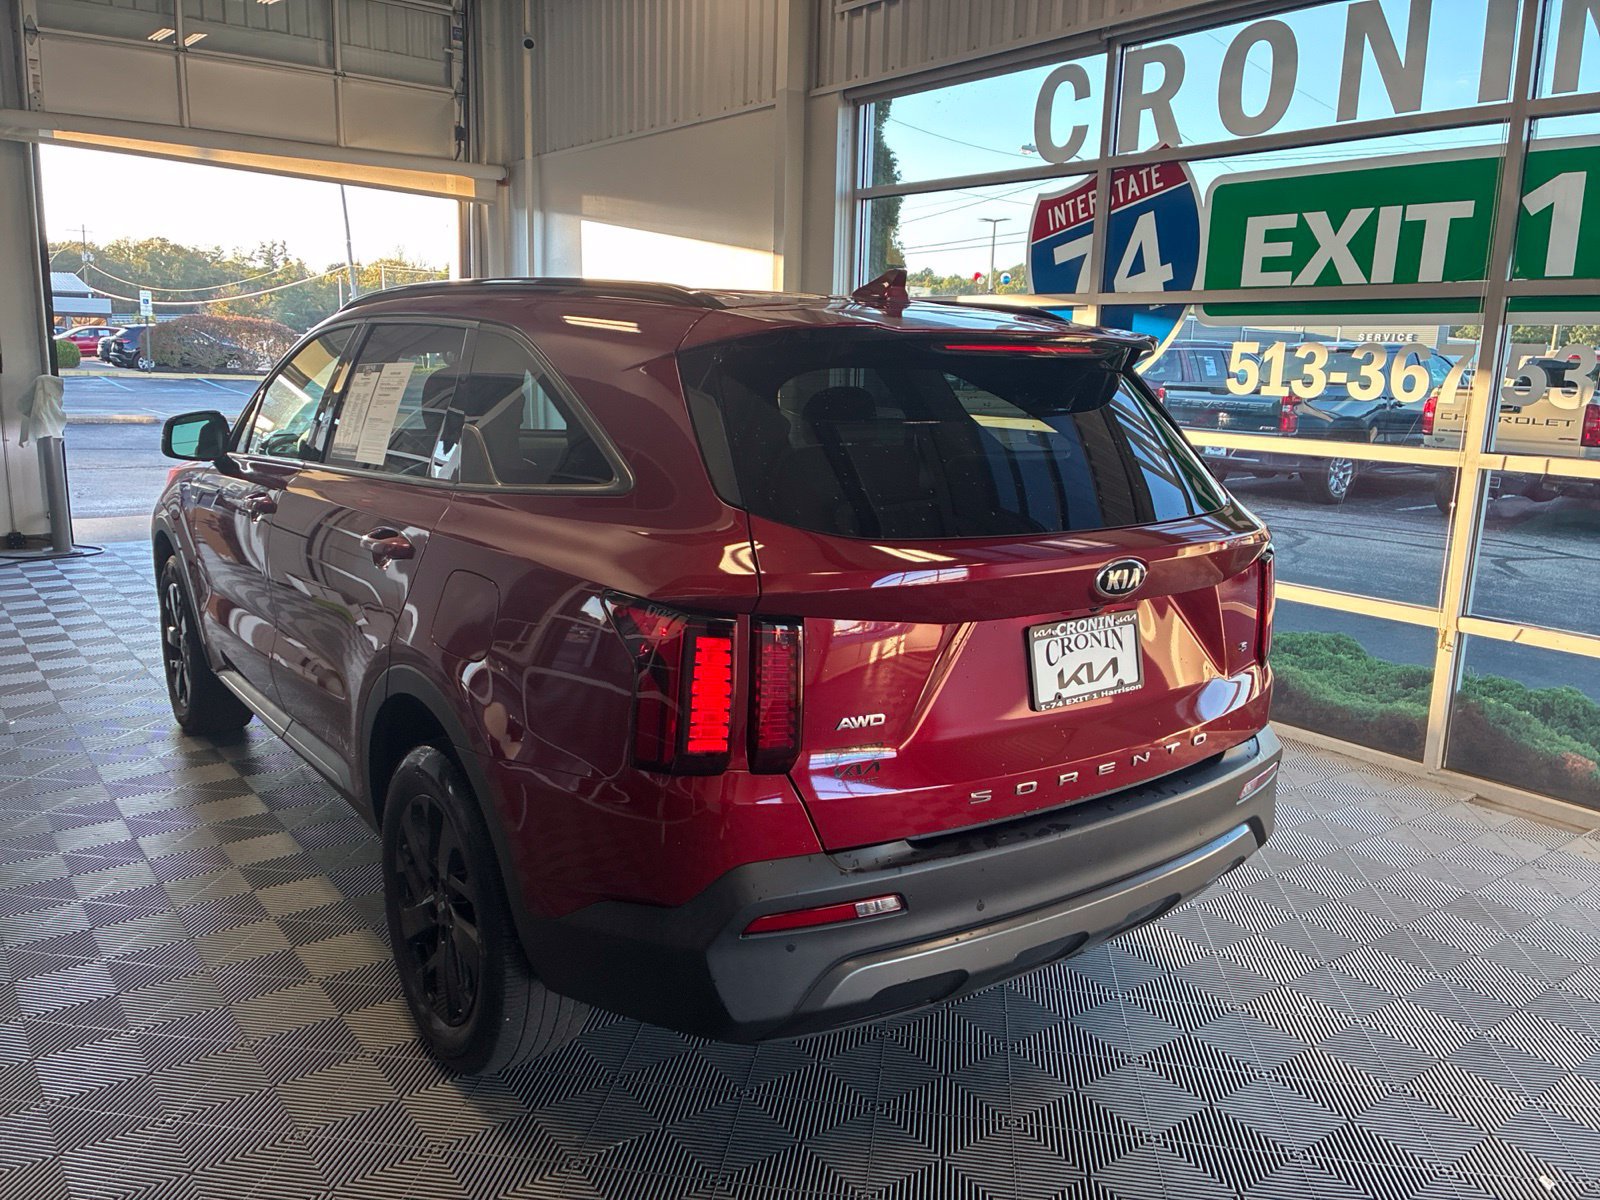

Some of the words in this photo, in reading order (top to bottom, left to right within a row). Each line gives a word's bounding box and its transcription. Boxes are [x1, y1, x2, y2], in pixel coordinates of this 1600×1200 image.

[1047, 164, 1164, 231] INTERTATE
[1240, 200, 1476, 288] EXIT
[1522, 171, 1587, 277] 1
[1053, 210, 1174, 311] 74
[1358, 332, 1415, 342] SERVICE
[1440, 412, 1575, 427] CHROLET
[1105, 567, 1141, 590] KIA
[1057, 614, 1115, 636] CRONIN
[1045, 626, 1124, 667] CRONIN
[1057, 656, 1119, 690] KIA
[1040, 697, 1063, 711] I-74
[1066, 694, 1091, 706] EXIT
[1092, 691, 1099, 700] 1
[1101, 684, 1142, 698] Harrison
[835, 713, 886, 731] AWD
[969, 732, 1207, 804] SORENTO
